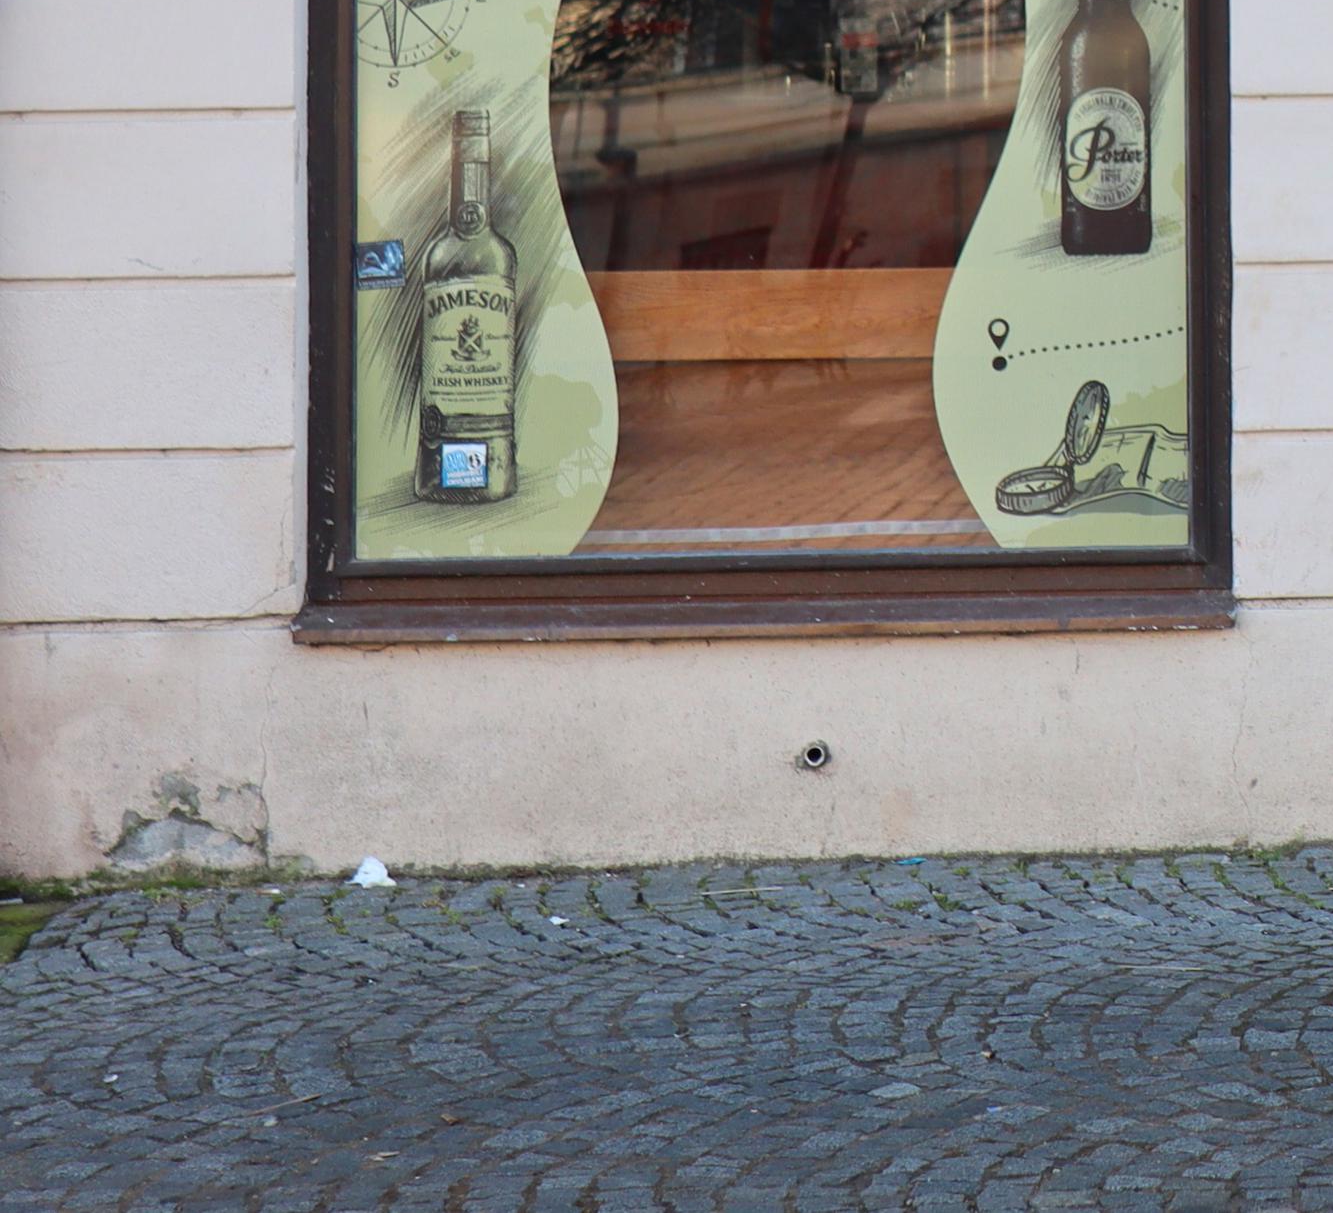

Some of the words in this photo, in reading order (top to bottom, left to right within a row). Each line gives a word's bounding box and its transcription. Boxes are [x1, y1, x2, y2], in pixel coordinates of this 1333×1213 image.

[388, 71, 400, 88] S
[1067, 116, 1144, 182] Porter
[428, 290, 514, 318] JAMESON
[432, 377, 462, 387] IRISH
